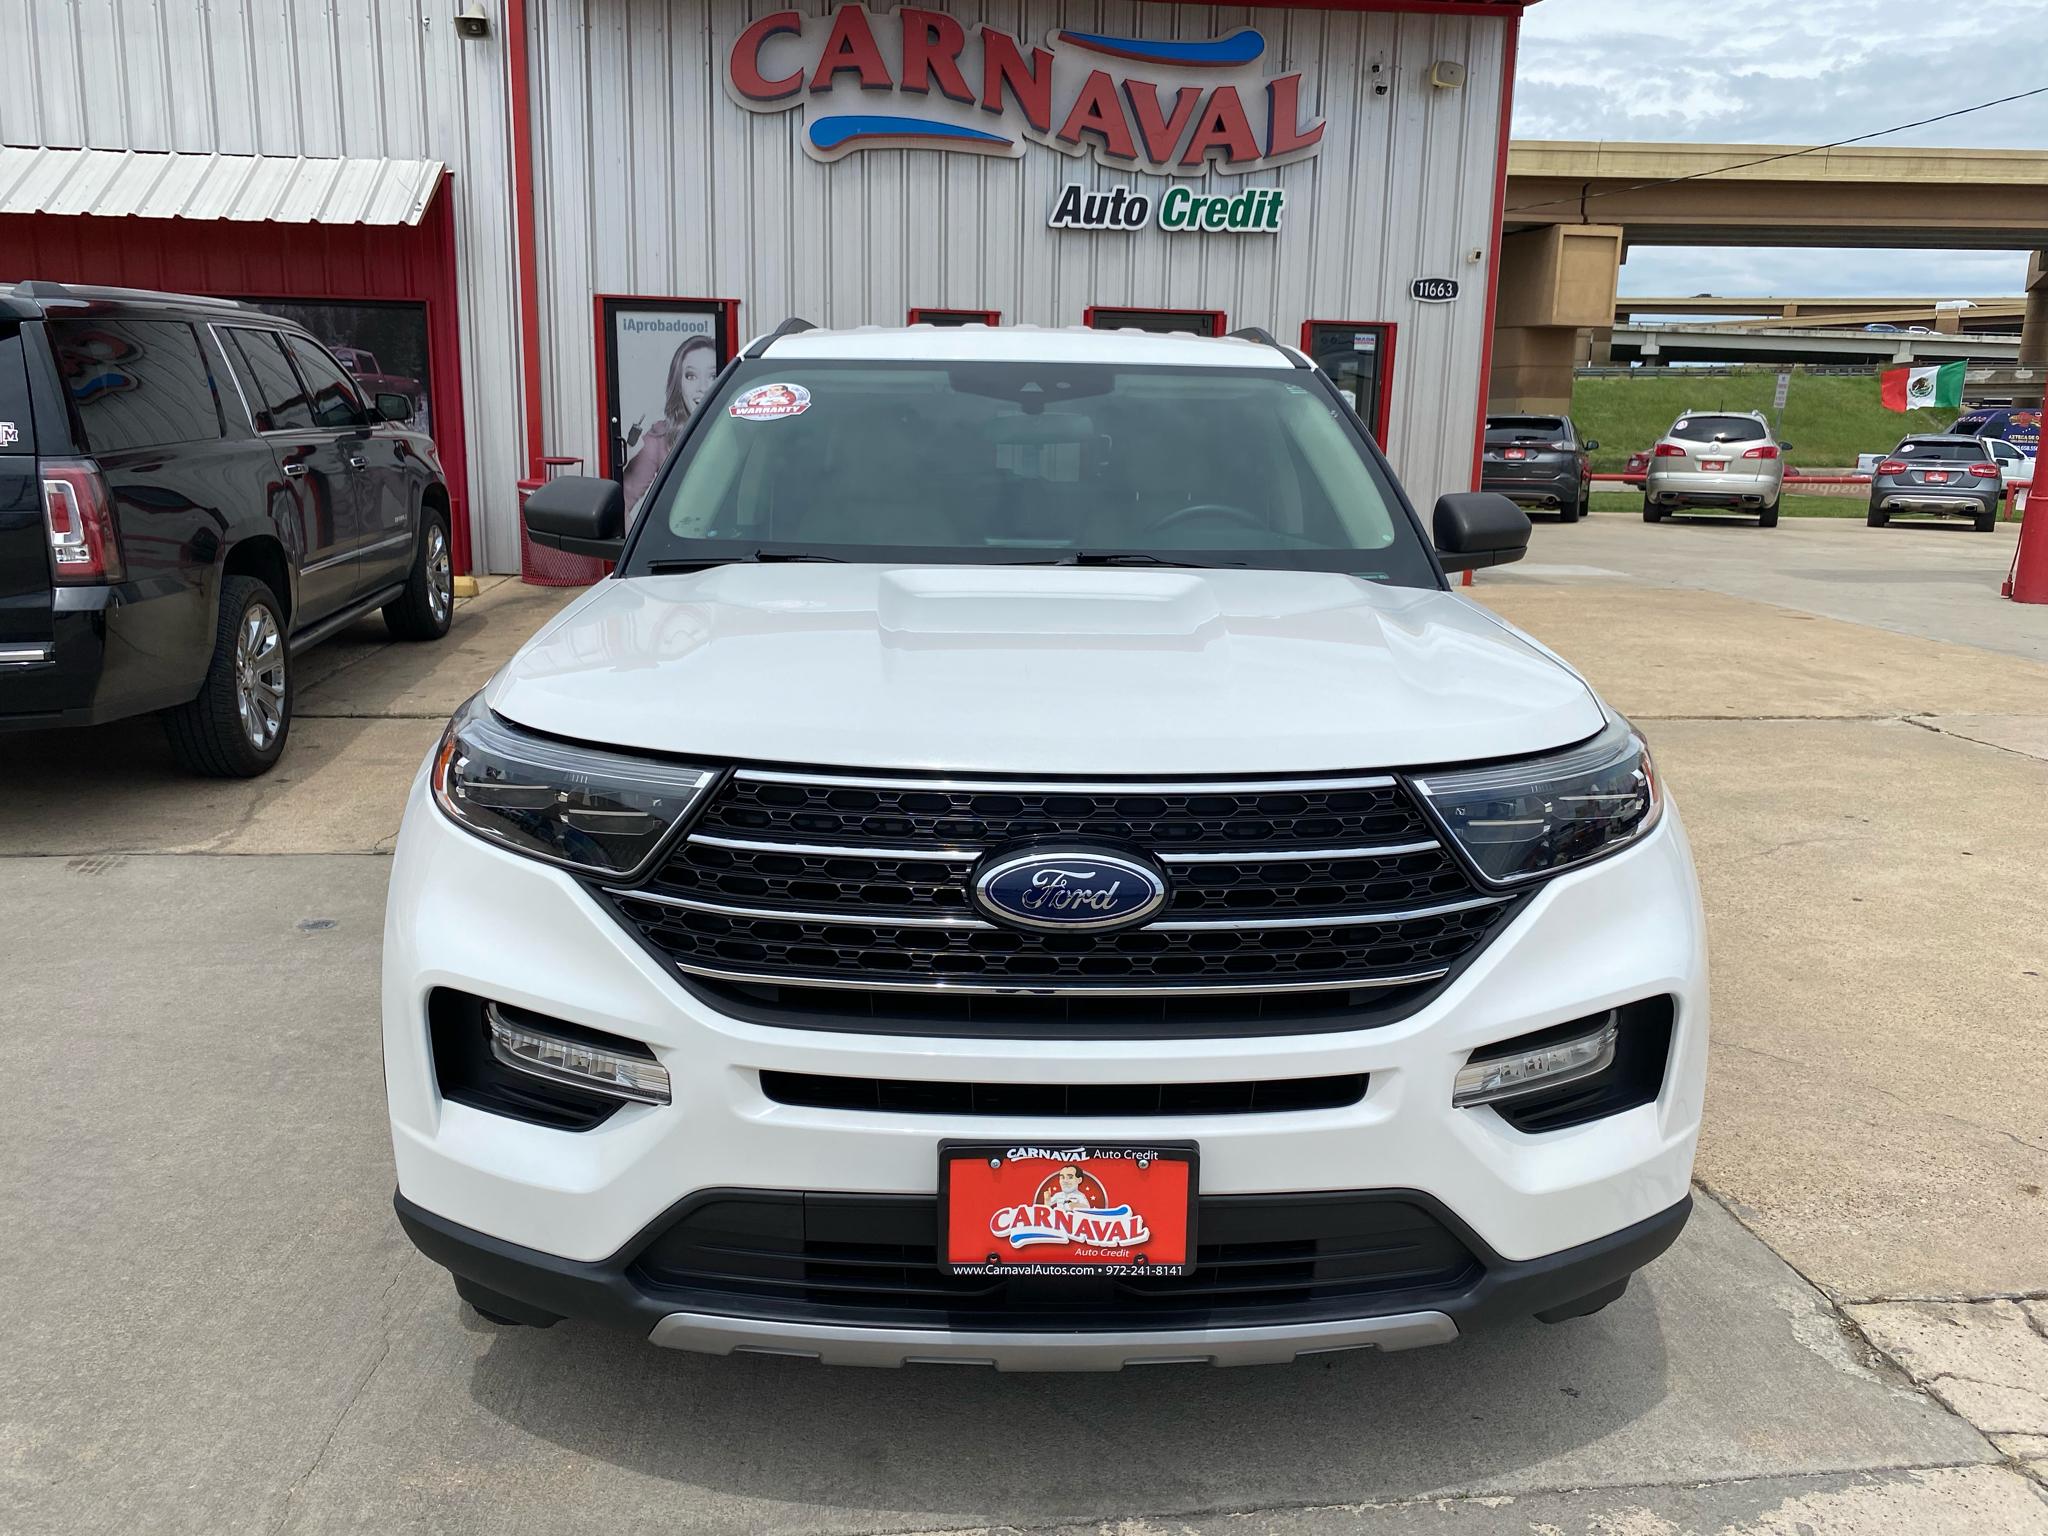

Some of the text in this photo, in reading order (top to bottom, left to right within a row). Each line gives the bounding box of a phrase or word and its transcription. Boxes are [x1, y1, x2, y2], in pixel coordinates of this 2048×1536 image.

[728, 4, 1326, 167] CARNAVAL
[1052, 185, 1284, 229] Auto Credit
[1417, 281, 1453, 297] 11663
[735, 406, 801, 415] WARRANTY
[1021, 869, 1121, 910] Ford
[1006, 1147, 1159, 1162] CARNAVAL Auto Credit
[990, 1206, 1146, 1243] CARNAVAL
[1074, 1248, 1130, 1258] Auto Credit
[953, 1264, 1183, 1276] www.CarnavalAutos.com 972-241-8141
